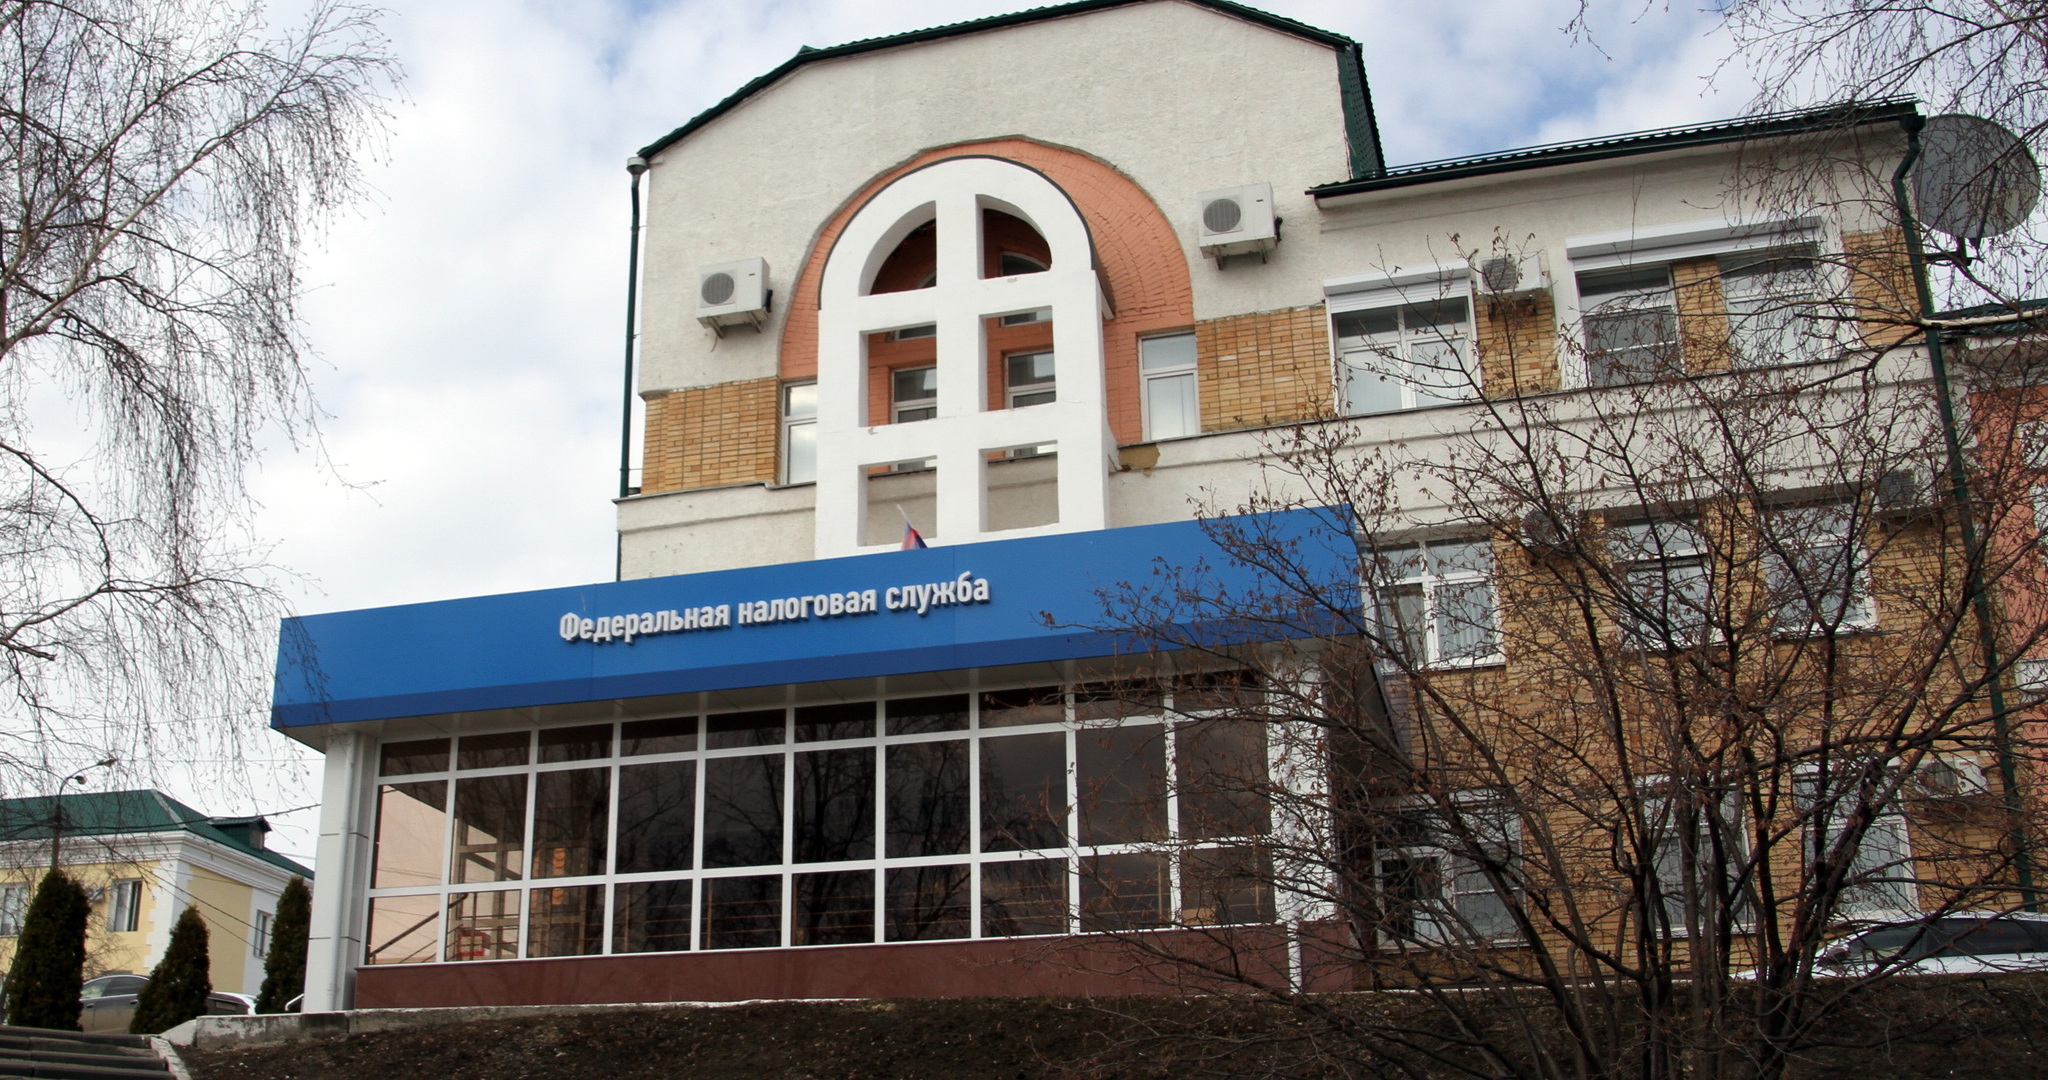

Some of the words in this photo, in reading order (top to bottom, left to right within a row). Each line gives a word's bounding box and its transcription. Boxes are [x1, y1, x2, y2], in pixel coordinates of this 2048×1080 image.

[559, 603, 730, 644] Федеральная
[737, 588, 877, 625] налоговая
[885, 571, 991, 617] служба
